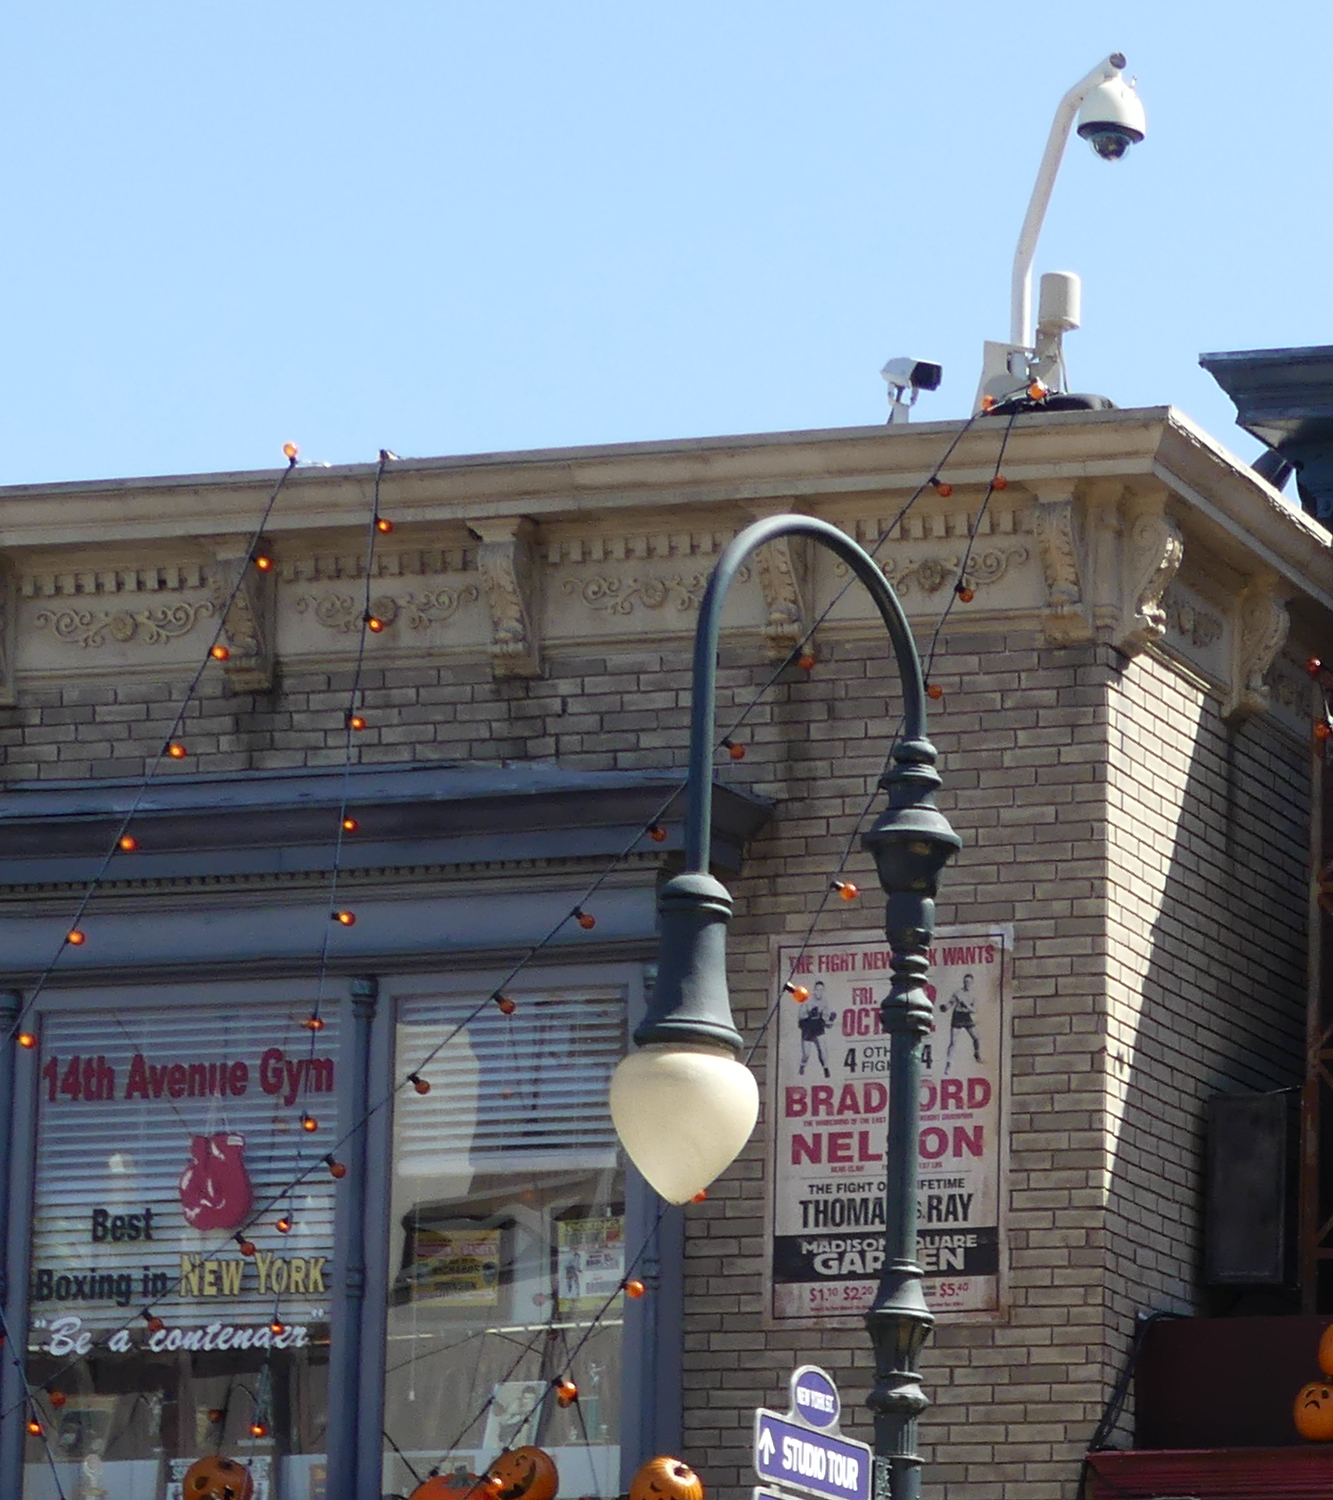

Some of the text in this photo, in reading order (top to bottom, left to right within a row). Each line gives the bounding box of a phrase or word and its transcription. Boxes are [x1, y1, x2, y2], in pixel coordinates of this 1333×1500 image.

[788, 954, 814, 975] THE
[817, 952, 858, 973] FIGHT
[942, 945, 995, 967] WANTS
[852, 987, 877, 1006] FRI.
[843, 1044, 933, 1073] 4 OTH 4
[43, 1047, 335, 1106] 14th Avenue Gym
[785, 1077, 992, 1118] BRADORD
[790, 1125, 985, 1165] NELON
[808, 1183, 833, 1195] THE
[836, 1182, 874, 1193] FIGHT
[917, 1177, 966, 1190] IFETIME
[92, 1208, 154, 1242] Best
[799, 1196, 886, 1229] THOMA
[927, 1192, 975, 1223] RAY
[812, 1247, 966, 1276] GAREN
[35, 1251, 327, 1306] Boxing in NEW YORK
[842, 1285, 874, 1300] $2.20
[939, 1281, 970, 1299] $5.40
[107, 1328, 133, 1351] a
[782, 1436, 859, 1491] STUDIO TOUR
